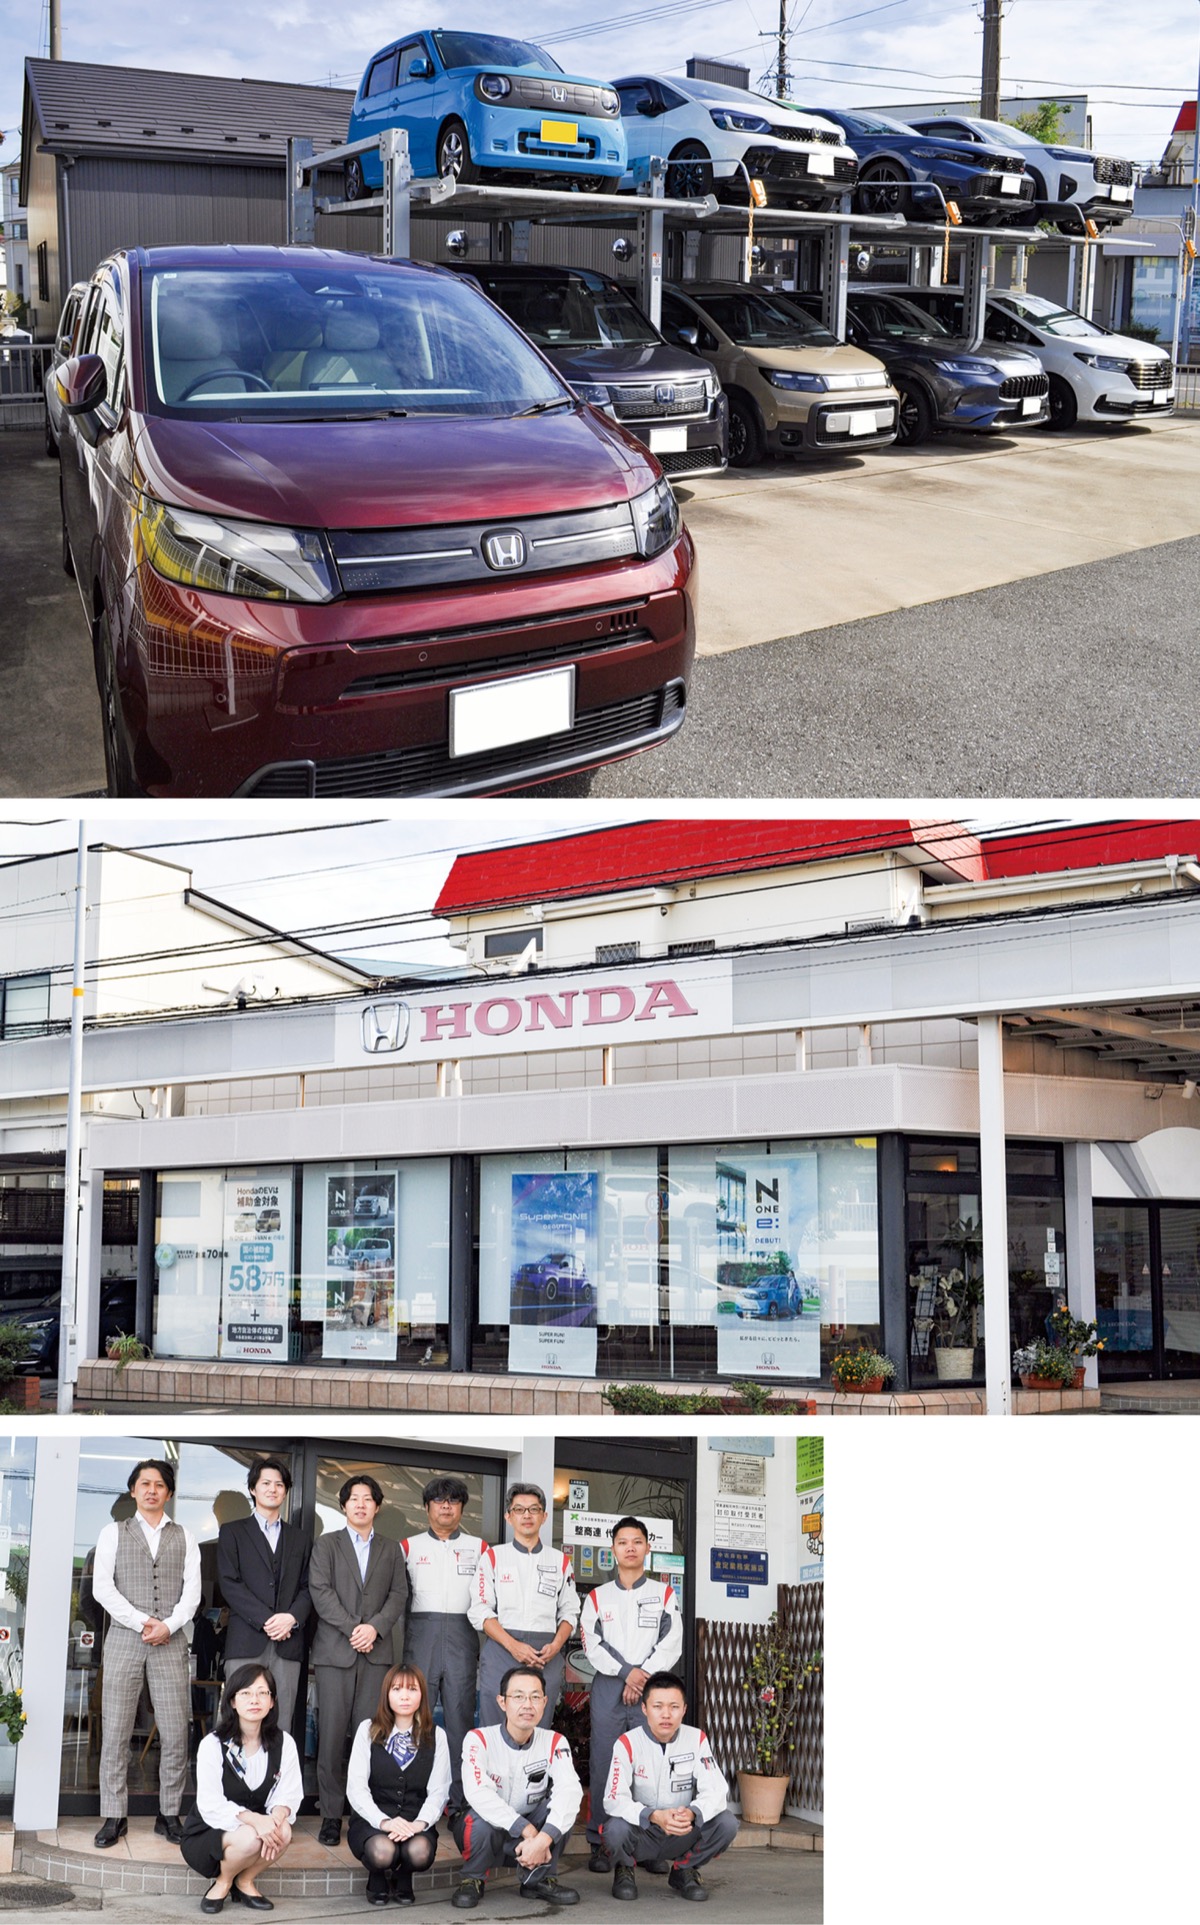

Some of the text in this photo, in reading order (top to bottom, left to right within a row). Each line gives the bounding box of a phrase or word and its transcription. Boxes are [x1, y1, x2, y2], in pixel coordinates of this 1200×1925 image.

[420, 979, 698, 1042] HONDA
[237, 1186, 279, 1195] HondaのEVは
[335, 1190, 346, 1202] N
[755, 1178, 779, 1204] N
[237, 1195, 278, 1207] 補助金対象
[755, 1204, 779, 1214] ONE
[334, 1245, 345, 1259] N
[228, 1264, 285, 1292] 58万円
[334, 1291, 345, 1304] N
